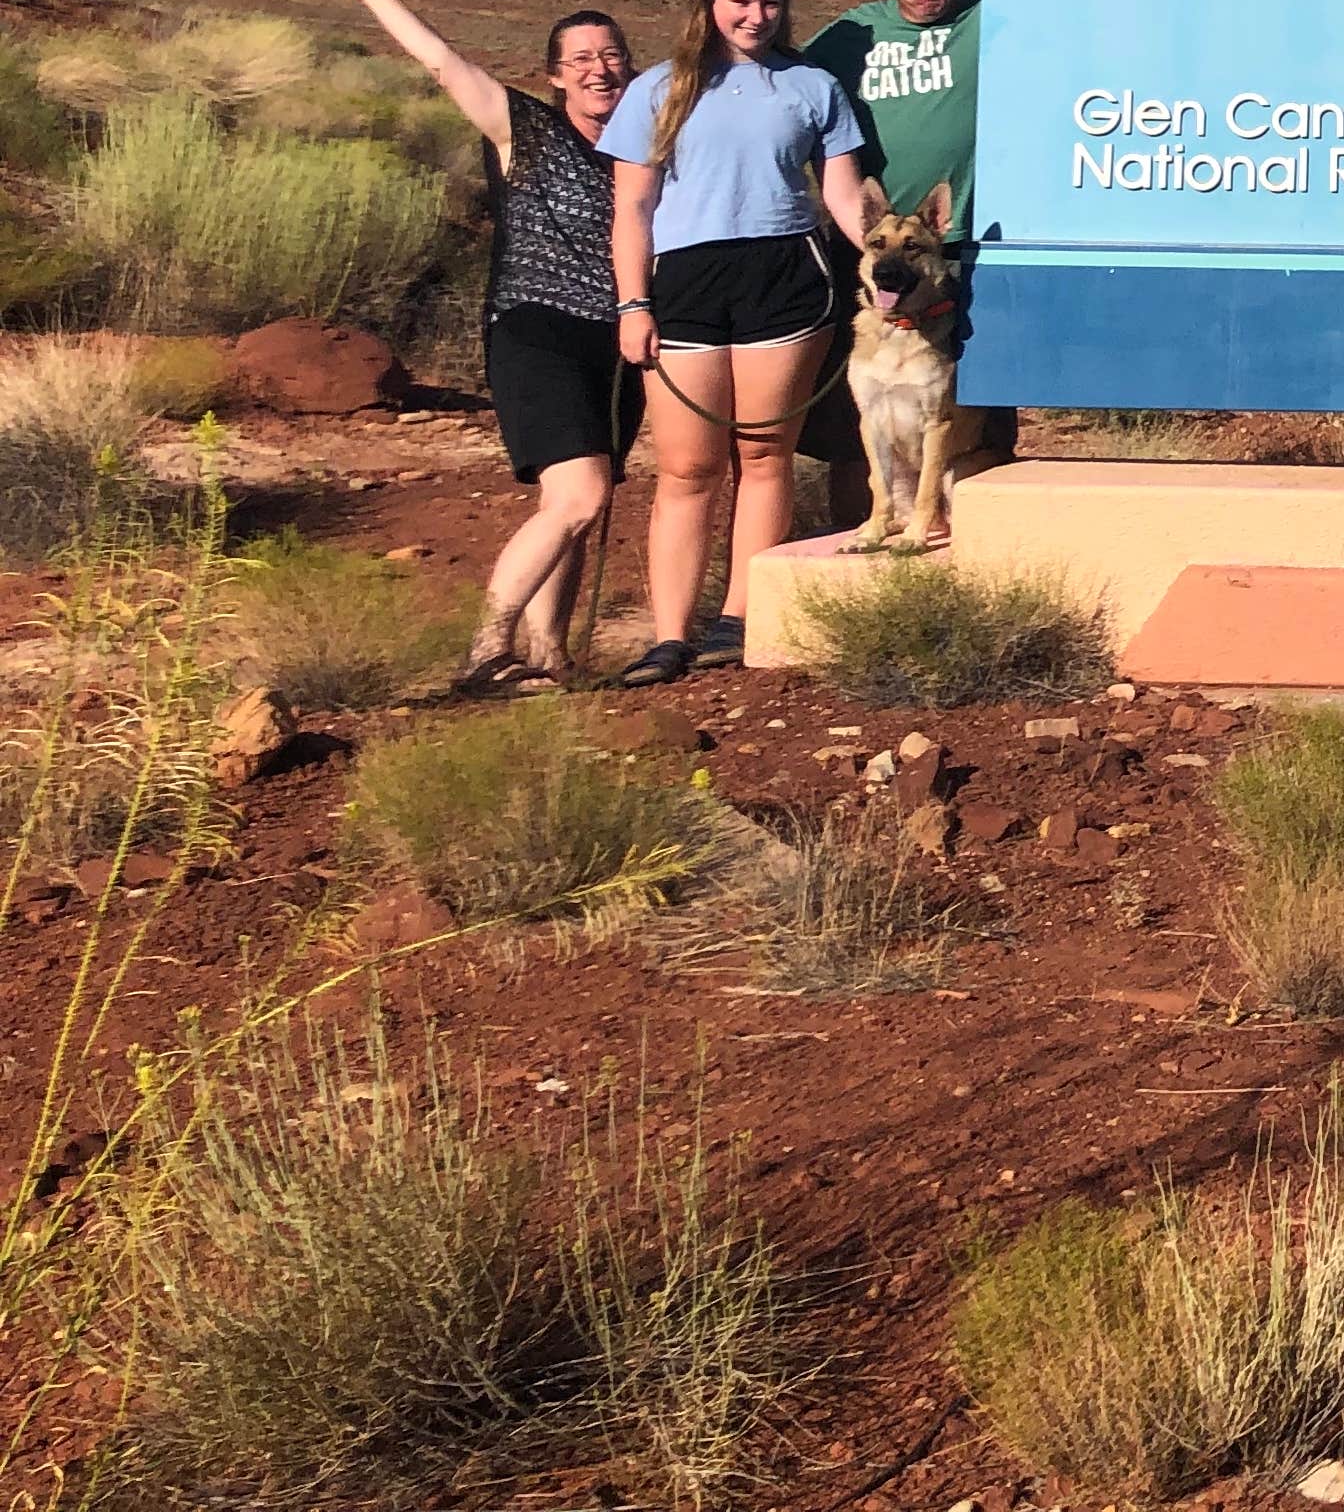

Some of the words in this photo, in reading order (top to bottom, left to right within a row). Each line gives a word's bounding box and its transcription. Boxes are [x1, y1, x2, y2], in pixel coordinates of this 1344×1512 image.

[861, 55, 953, 101] CATCH
[1073, 90, 1206, 138] Glen
[1073, 144, 1309, 194] National
